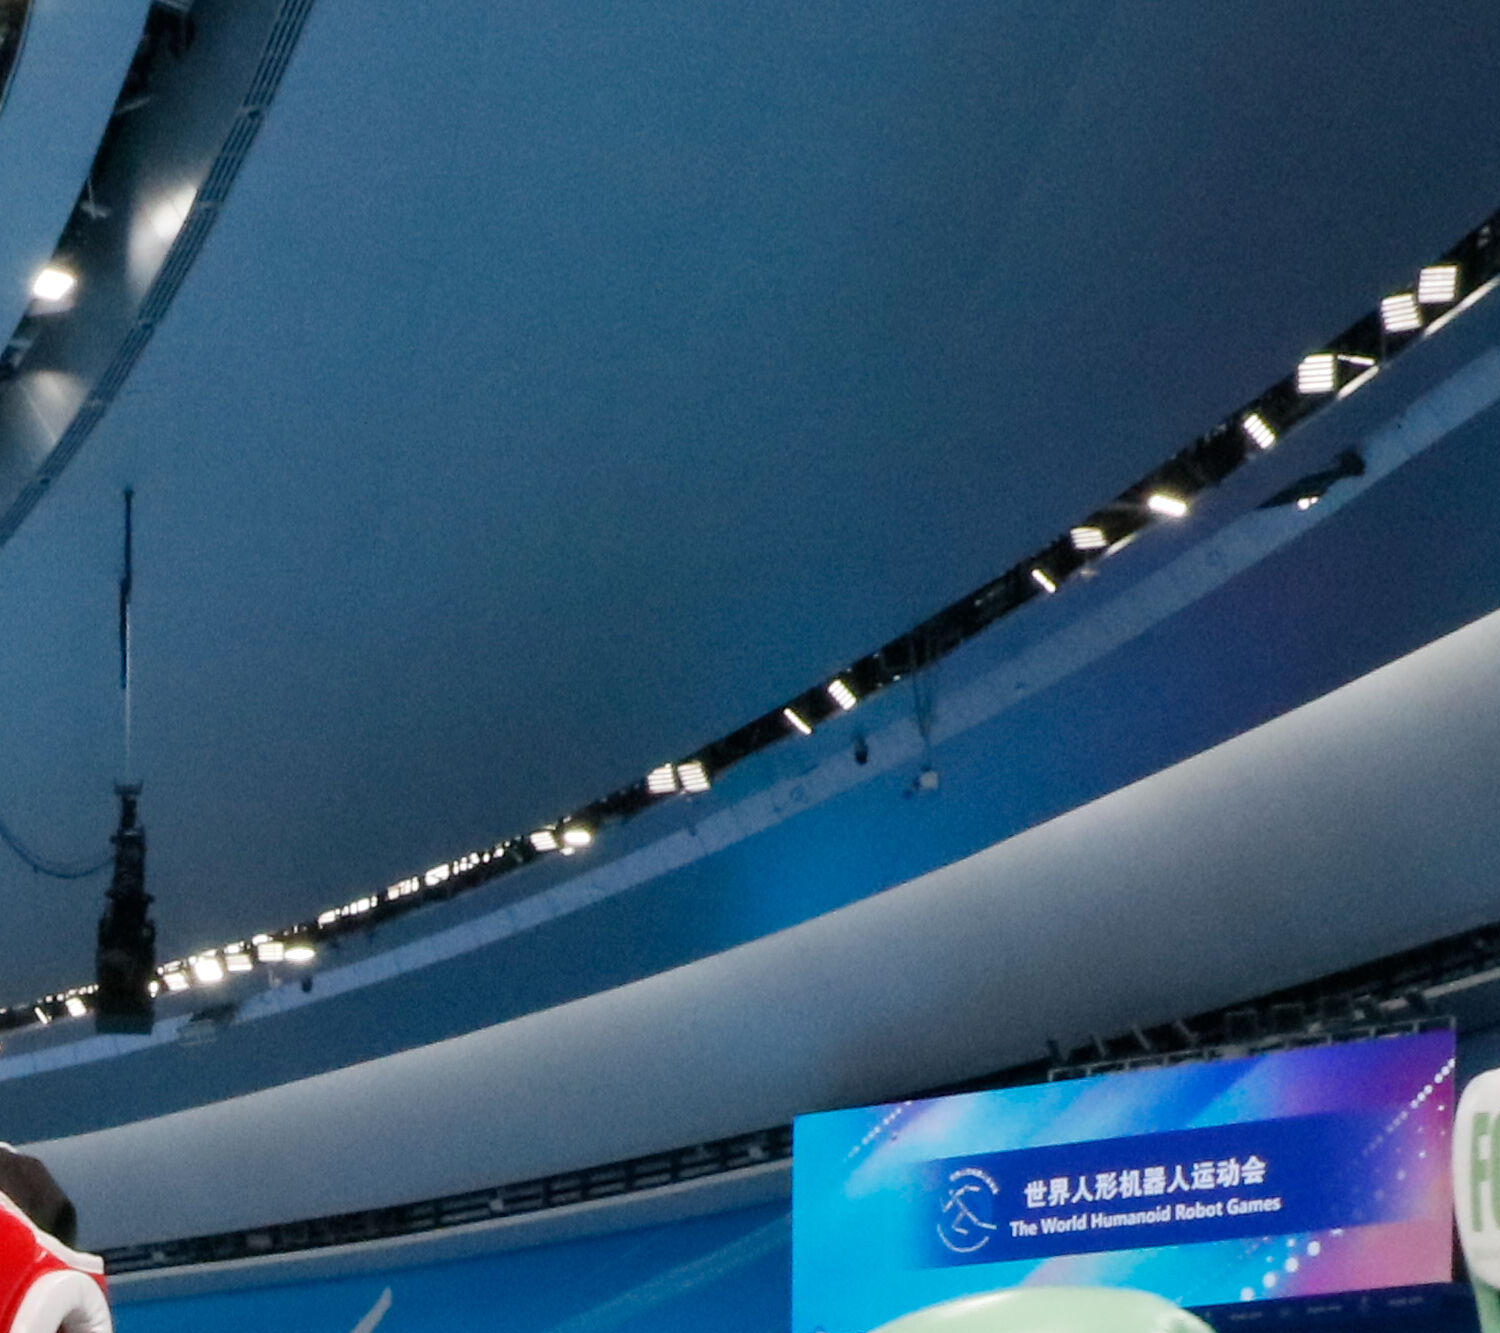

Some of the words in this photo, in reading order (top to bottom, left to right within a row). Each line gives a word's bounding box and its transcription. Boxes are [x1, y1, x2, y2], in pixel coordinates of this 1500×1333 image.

[1024, 1155, 1267, 1208] 世界人形机器人运动会
[1010, 1219, 1037, 1238] The
[1041, 1214, 1087, 1235] World
[1091, 1206, 1171, 1229] Humanoid
[1175, 1200, 1223, 1220] Robot
[1226, 1195, 1282, 1214] Games
